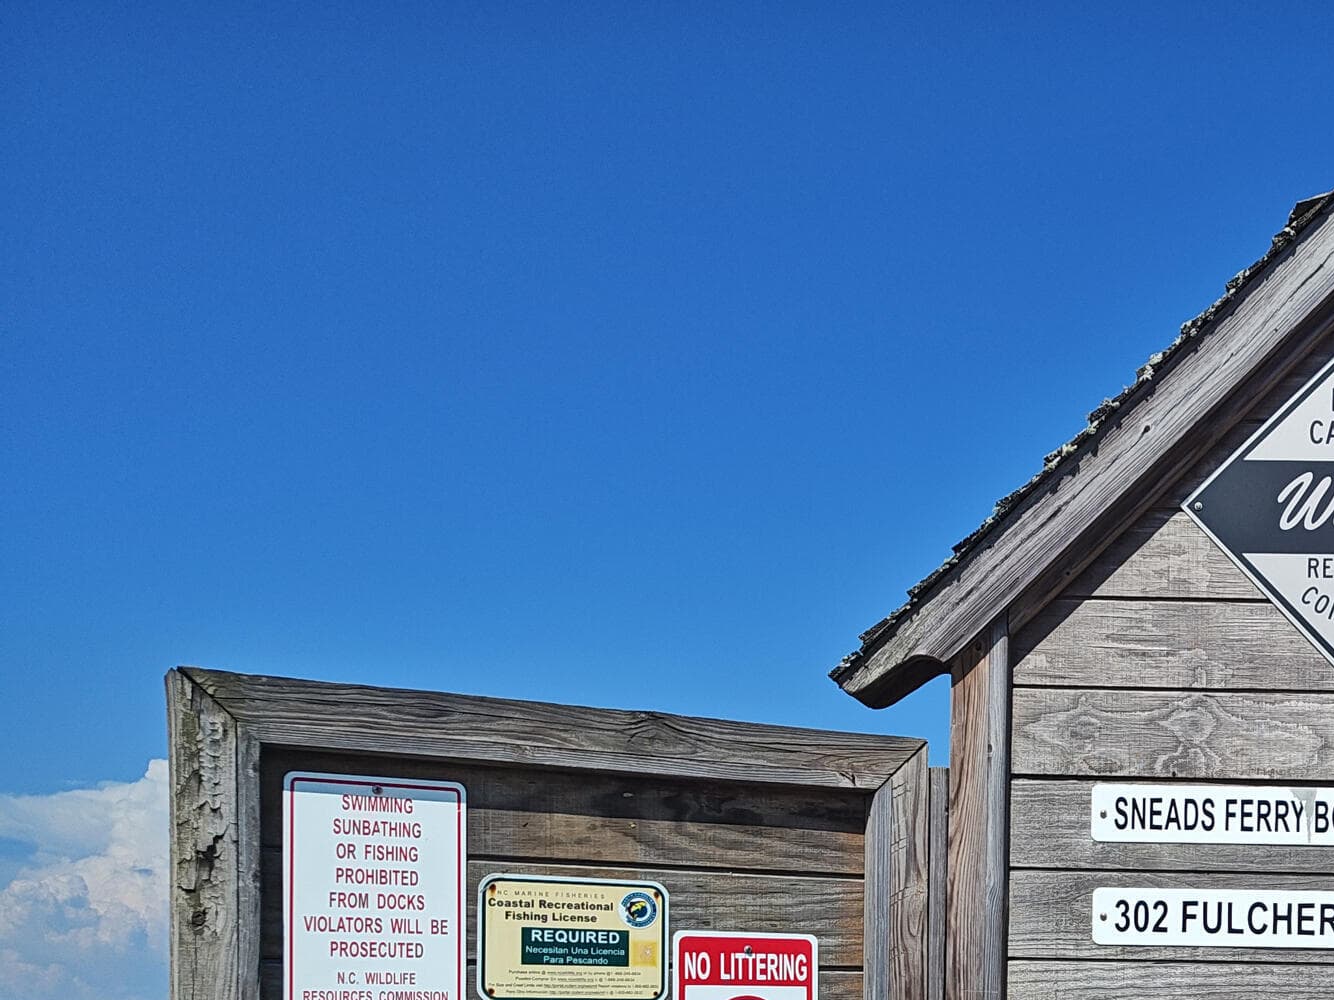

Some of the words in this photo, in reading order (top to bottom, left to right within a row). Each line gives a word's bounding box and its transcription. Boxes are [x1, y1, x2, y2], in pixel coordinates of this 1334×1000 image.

[342, 794, 413, 813] SWIMMING
[1115, 797, 1215, 831] SNEADS
[1225, 800, 1303, 832] FERRY
[333, 819, 421, 838] SUNBATHING
[336, 844, 356, 859] OR
[365, 845, 418, 861] FISHING
[336, 868, 418, 886] PROHIBITED
[330, 892, 368, 908] FROM
[377, 894, 424, 910] DOCKS
[488, 898, 534, 907] Coastal
[539, 900, 614, 910] Recreational
[304, 916, 382, 933] VIOLATORS
[391, 919, 422, 934] WILL
[431, 920, 448, 934] BE
[505, 911, 547, 923] Fishing
[552, 913, 597, 922] License
[1115, 900, 1168, 932] 302
[531, 930, 620, 944] REQUIRED
[330, 942, 423, 958] PROSECUTED
[526, 946, 568, 954] Necesitan
[571, 946, 588, 954] Una
[591, 947, 625, 956] Licencia
[685, 952, 710, 980] NO
[720, 953, 807, 982] LITTERING
[337, 972, 359, 984] N.C.
[365, 972, 416, 984] WILDLIFE
